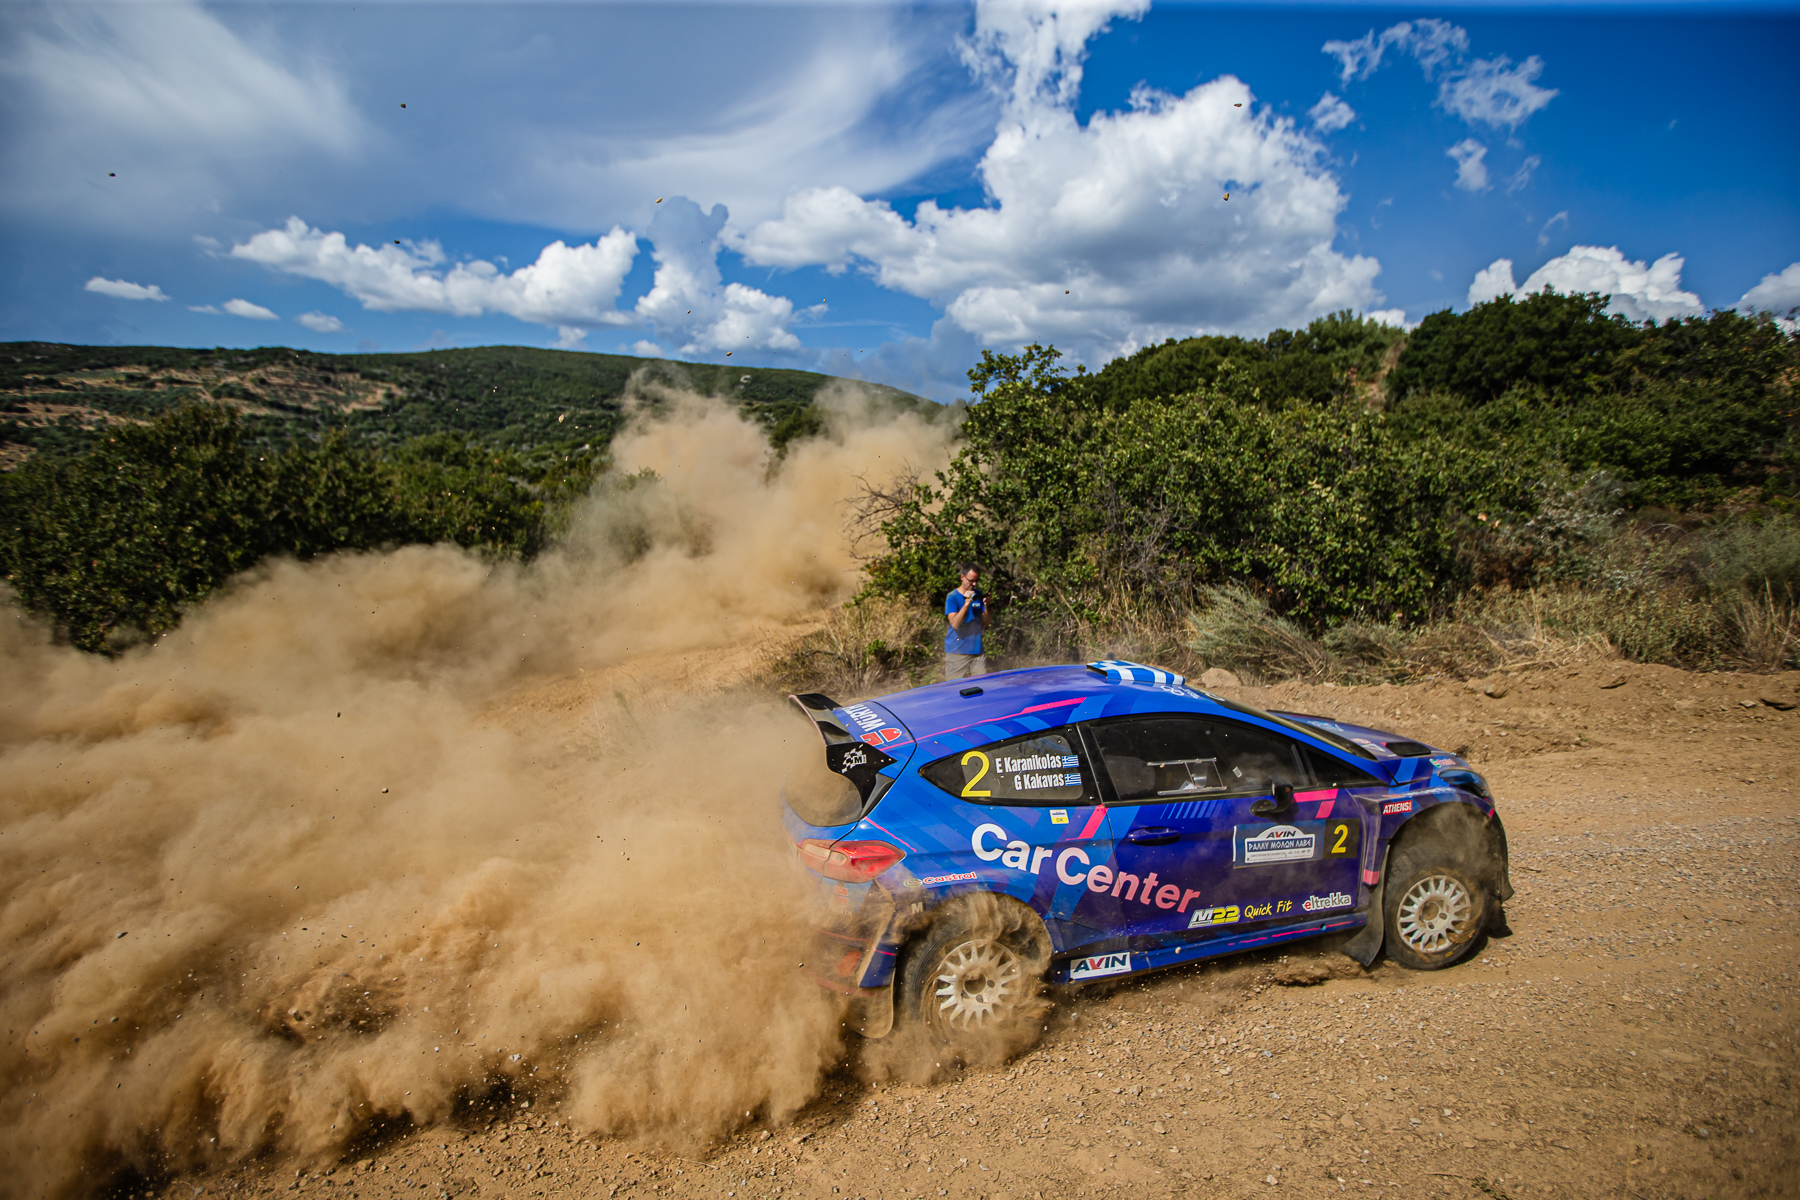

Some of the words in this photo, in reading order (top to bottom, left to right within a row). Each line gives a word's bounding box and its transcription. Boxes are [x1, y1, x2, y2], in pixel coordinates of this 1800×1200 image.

[995, 757, 1003, 774] E
[1003, 753, 1062, 773] Karanikolas
[961, 751, 991, 797] 2
[1014, 774, 1022, 791] G
[1023, 773, 1065, 790] Kakavas
[1267, 830, 1296, 838] AVIN
[1331, 824, 1348, 853] 2
[923, 871, 977, 885] Castrol
[1244, 903, 1273, 918] Quick
[1276, 900, 1293, 914] Fit
[1303, 892, 1352, 911] eltrekka
[1073, 953, 1128, 973] AVIN
